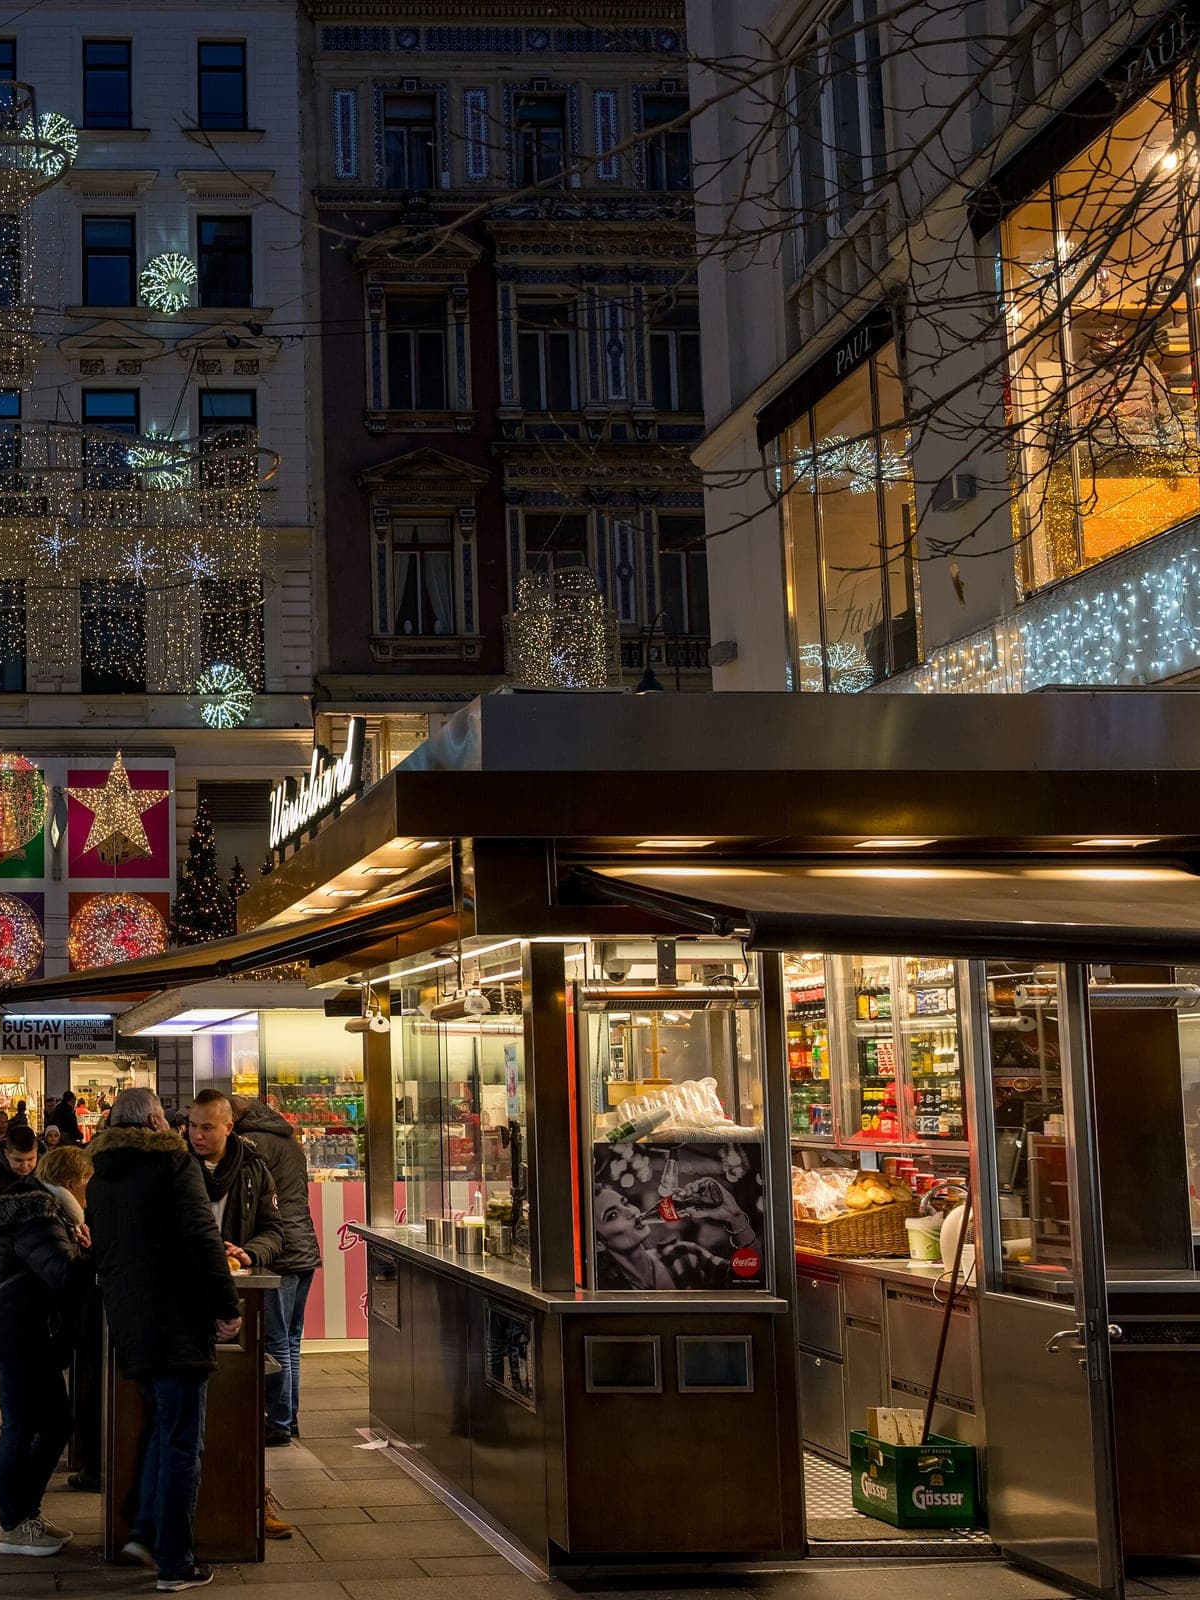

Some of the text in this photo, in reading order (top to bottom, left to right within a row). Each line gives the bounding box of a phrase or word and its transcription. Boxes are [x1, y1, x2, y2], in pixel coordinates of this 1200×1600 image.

[835, 326, 872, 377] PAUL
[2, 1020, 61, 1033] GUSTAV
[65, 1020, 104, 1028] INSPIRATIONS
[65, 1027, 112, 1035] REPRODUCTIONS
[2, 1034, 61, 1050] KLIMT
[65, 1034, 94, 1042] ANTIQUES
[912, 1484, 965, 1510] Gösser
